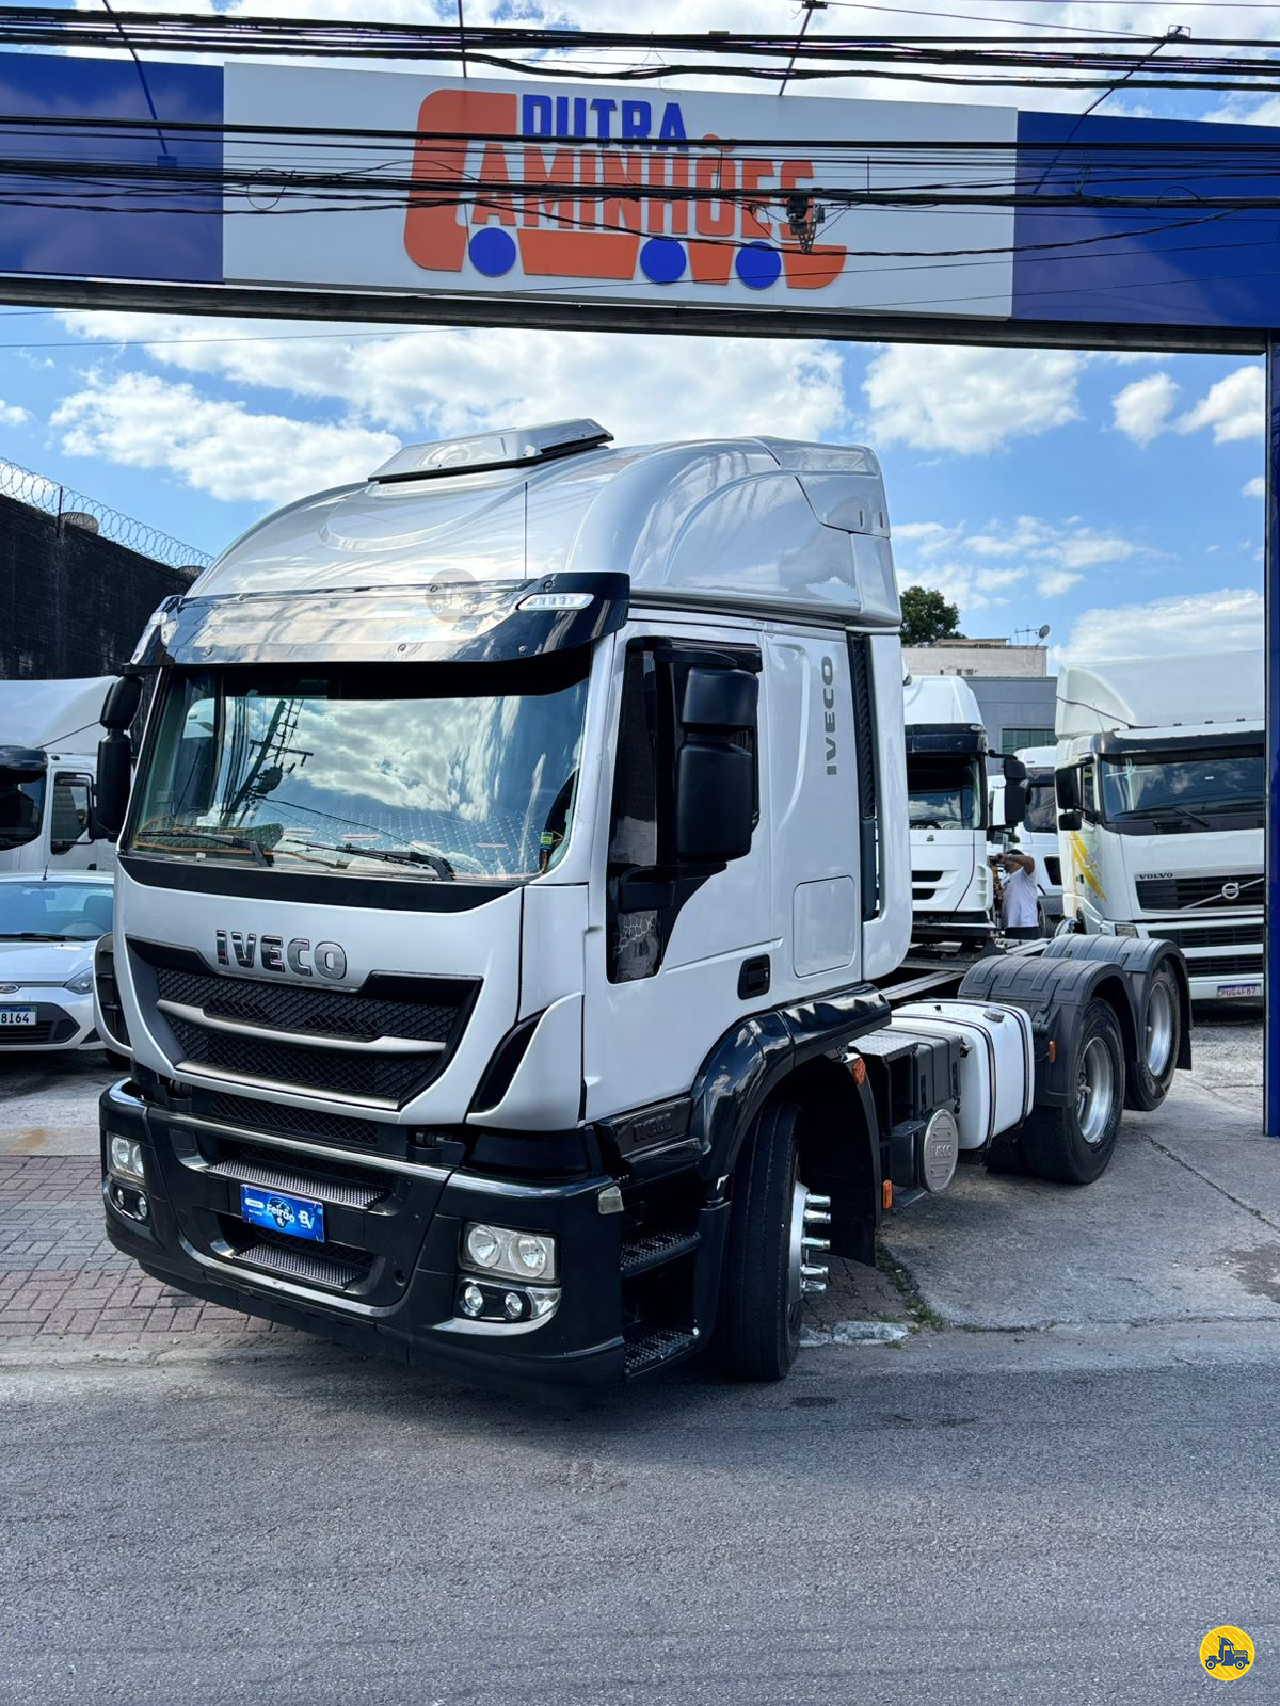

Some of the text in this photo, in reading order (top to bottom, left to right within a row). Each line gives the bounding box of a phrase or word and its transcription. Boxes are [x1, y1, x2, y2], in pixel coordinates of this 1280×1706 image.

[522, 93, 689, 152] DUTRA
[821, 656, 837, 776] IVECO
[1139, 872, 1173, 880] VOLVO
[216, 929, 348, 981] IVECO
